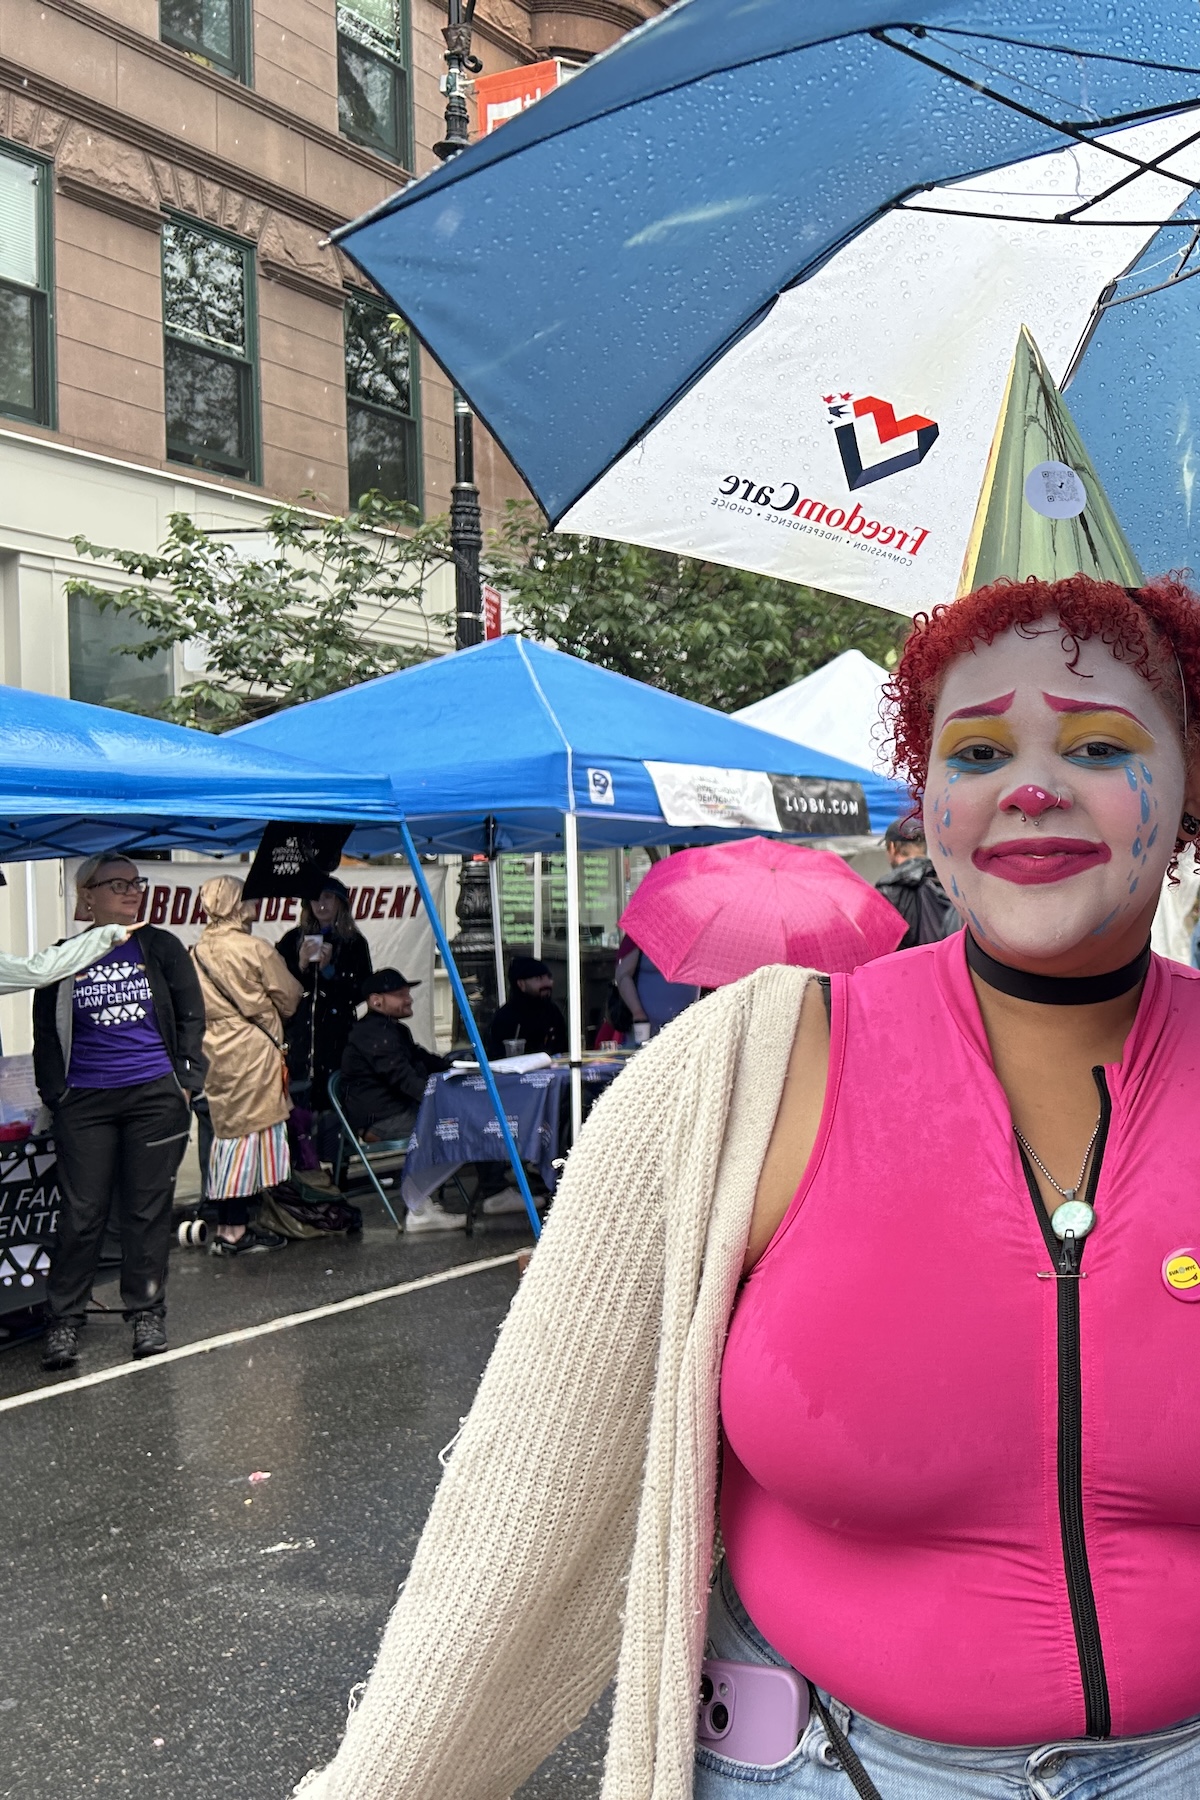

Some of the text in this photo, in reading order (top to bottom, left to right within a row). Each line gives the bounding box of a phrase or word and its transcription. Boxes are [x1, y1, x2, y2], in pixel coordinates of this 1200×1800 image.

[785, 795, 859, 816] LIDBK.COM
[121, 977, 150, 991] FAMI
[78, 995, 103, 1009] LAW
[0, 1210, 61, 1239] ENTE
